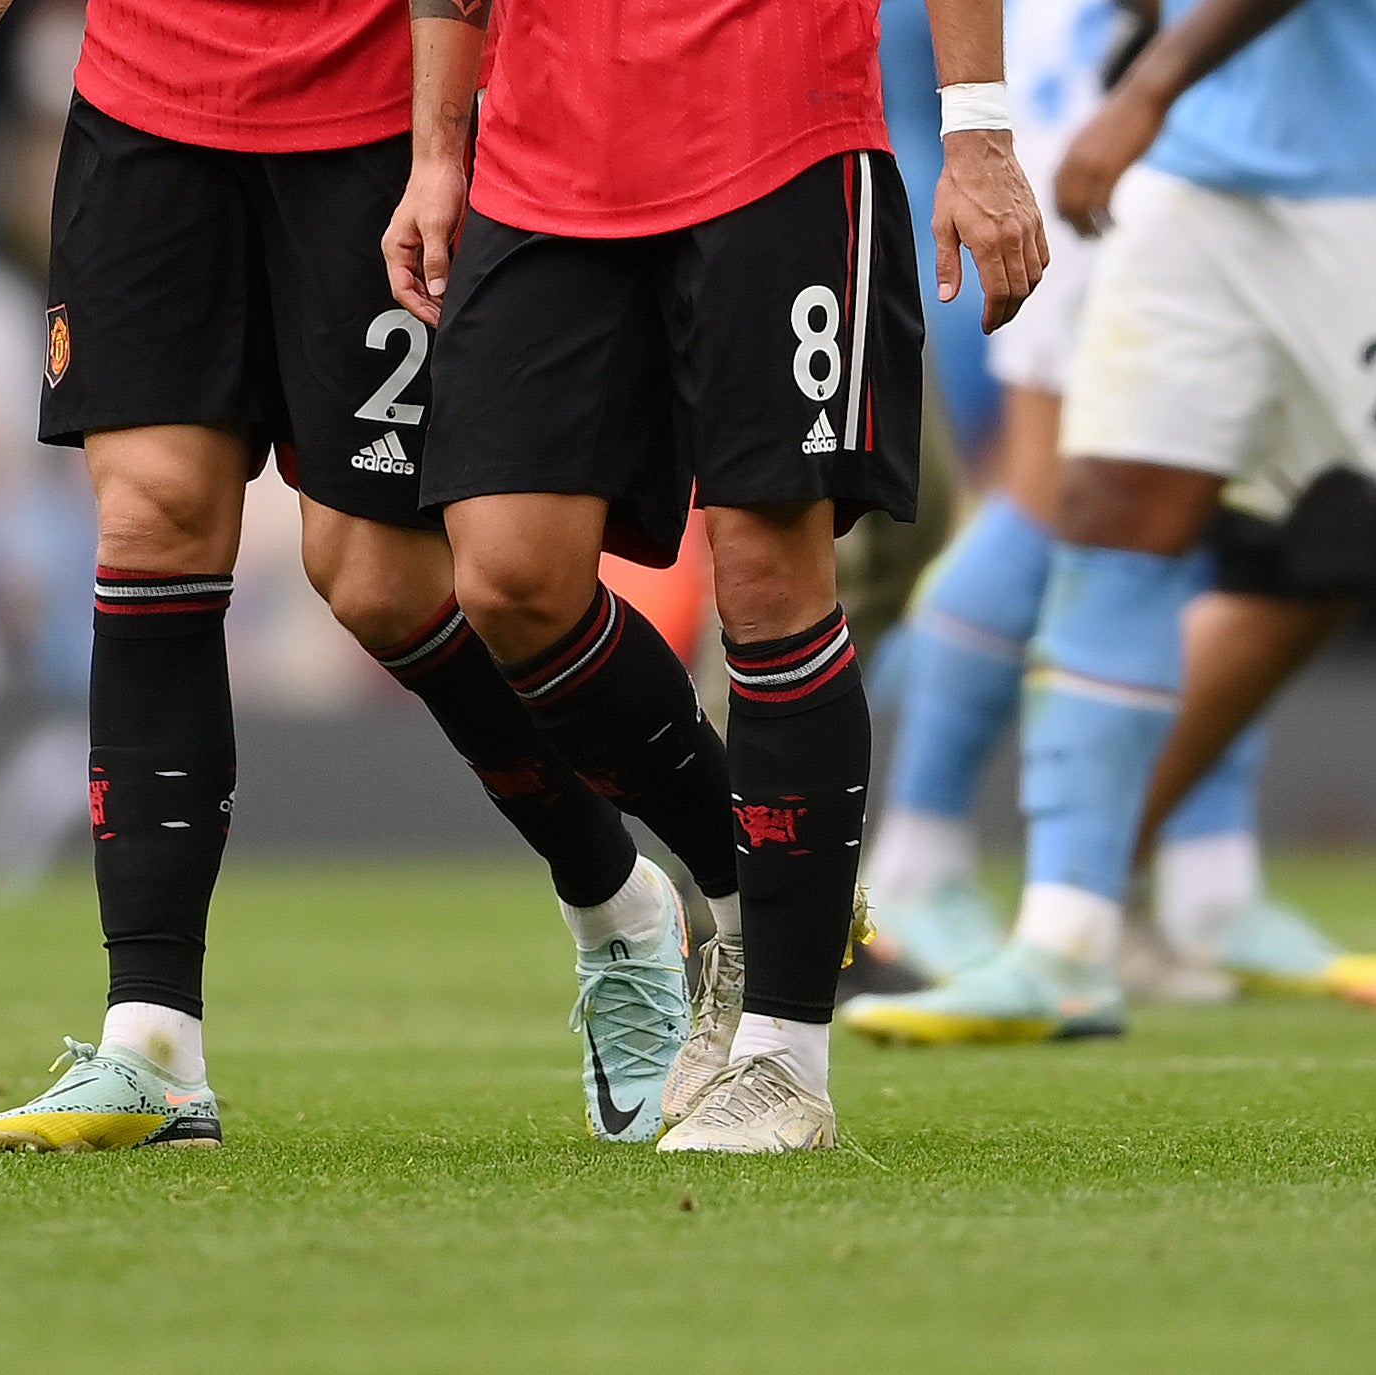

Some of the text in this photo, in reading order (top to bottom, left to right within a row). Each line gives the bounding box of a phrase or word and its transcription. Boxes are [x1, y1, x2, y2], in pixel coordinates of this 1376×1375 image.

[354, 308, 429, 426] 2
[790, 284, 842, 402] 8
[350, 454, 415, 476] adidas
